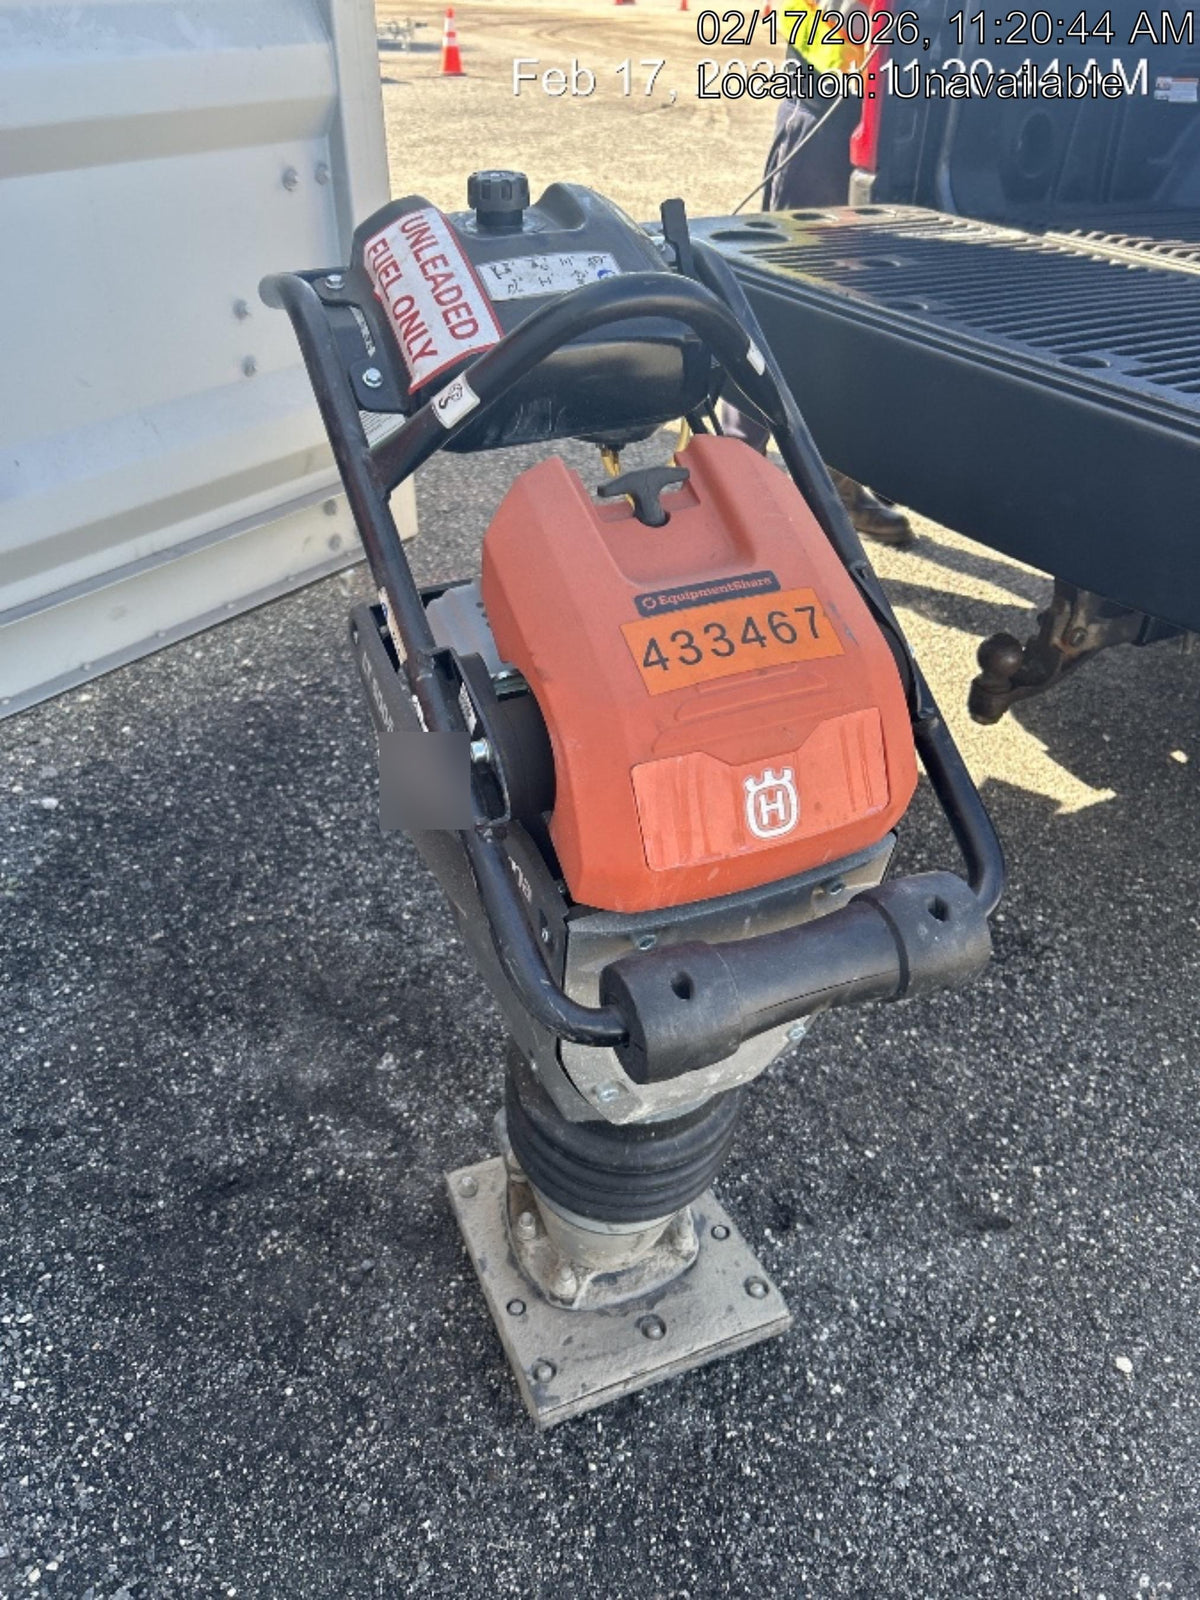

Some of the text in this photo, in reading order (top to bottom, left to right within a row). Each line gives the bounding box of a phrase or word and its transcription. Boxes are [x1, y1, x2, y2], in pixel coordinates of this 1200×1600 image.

[367, 237, 438, 363] FUEL ONLY
[401, 214, 480, 341] UNLEADED
[642, 605, 820, 671] 433467
[657, 575, 773, 607] EquipmentShare
